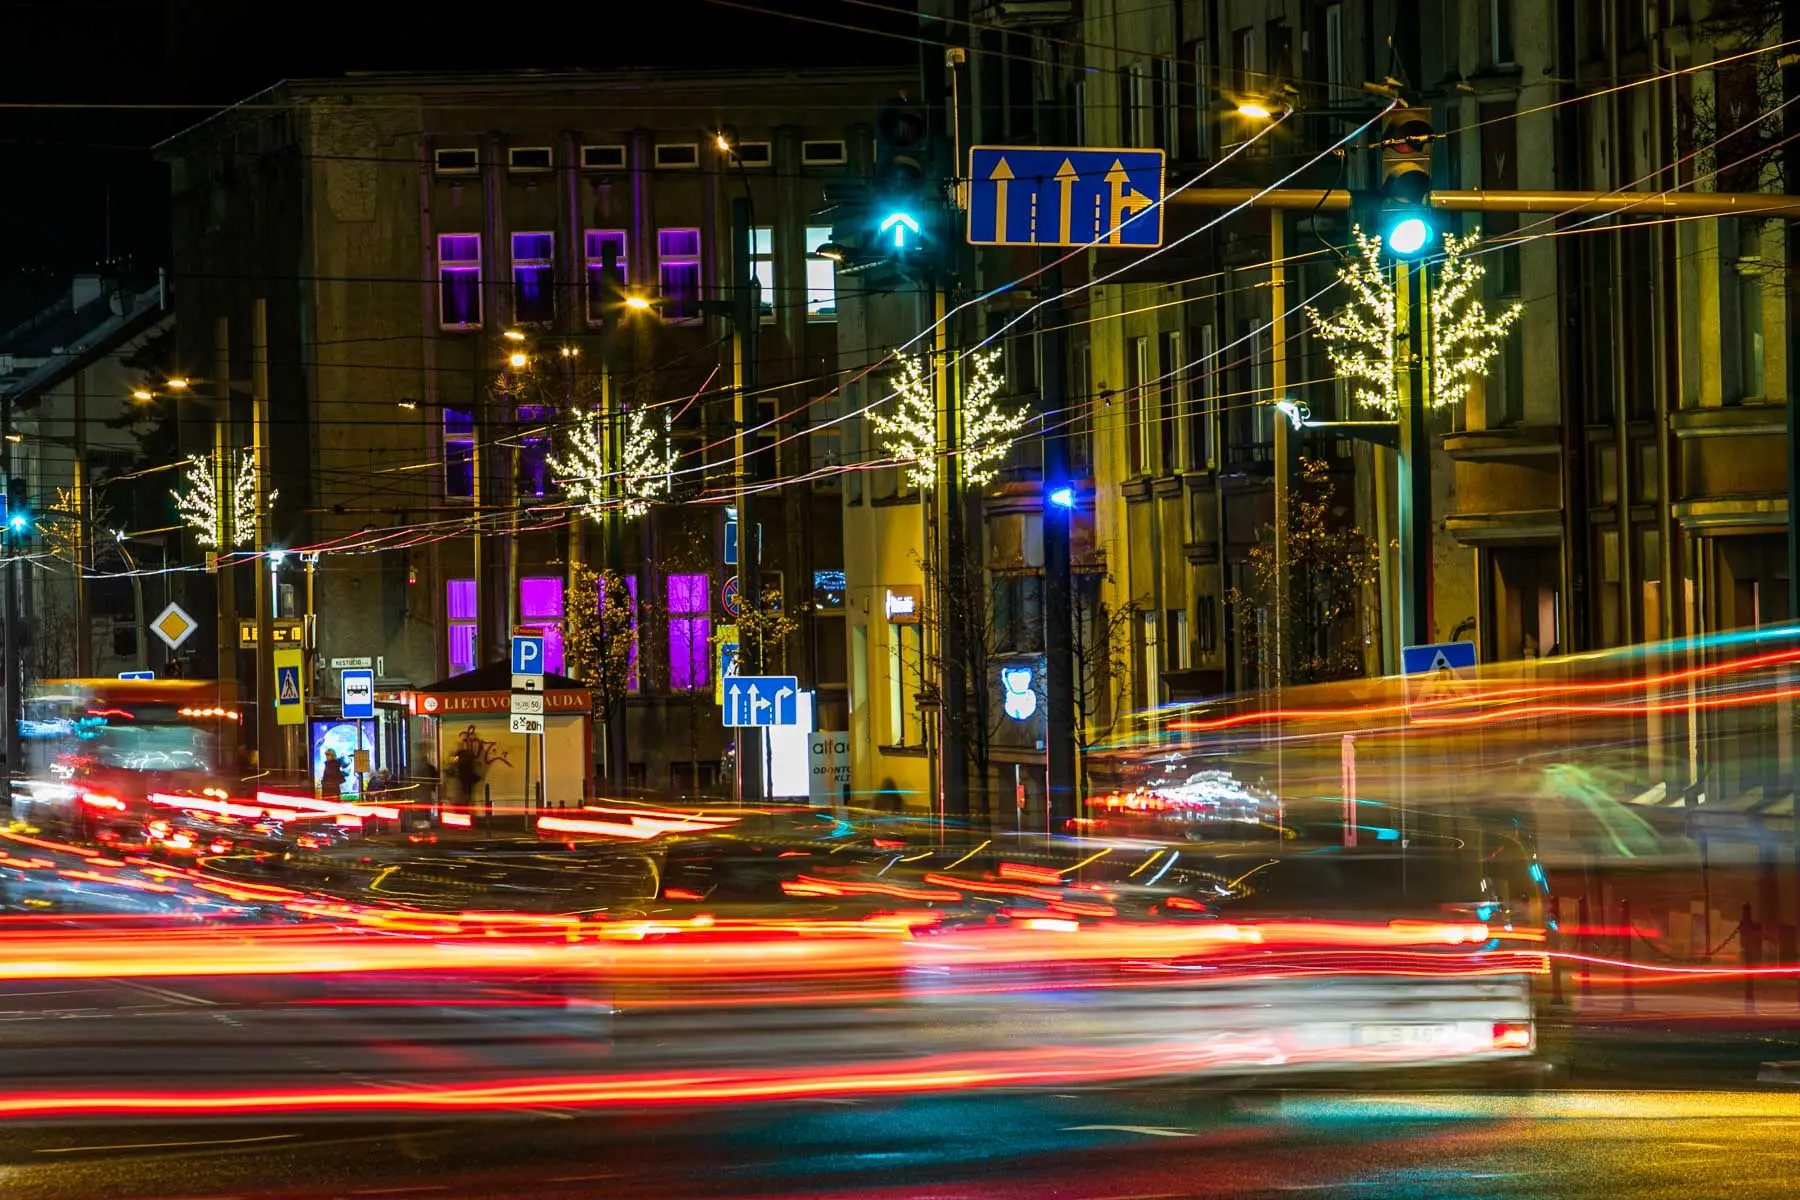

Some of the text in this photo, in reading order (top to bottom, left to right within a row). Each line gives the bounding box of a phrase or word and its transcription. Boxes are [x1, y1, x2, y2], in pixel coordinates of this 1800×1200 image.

[520, 641, 538, 671] P
[444, 695, 584, 710] LIETUVO AUDA
[531, 700, 539, 708] 50
